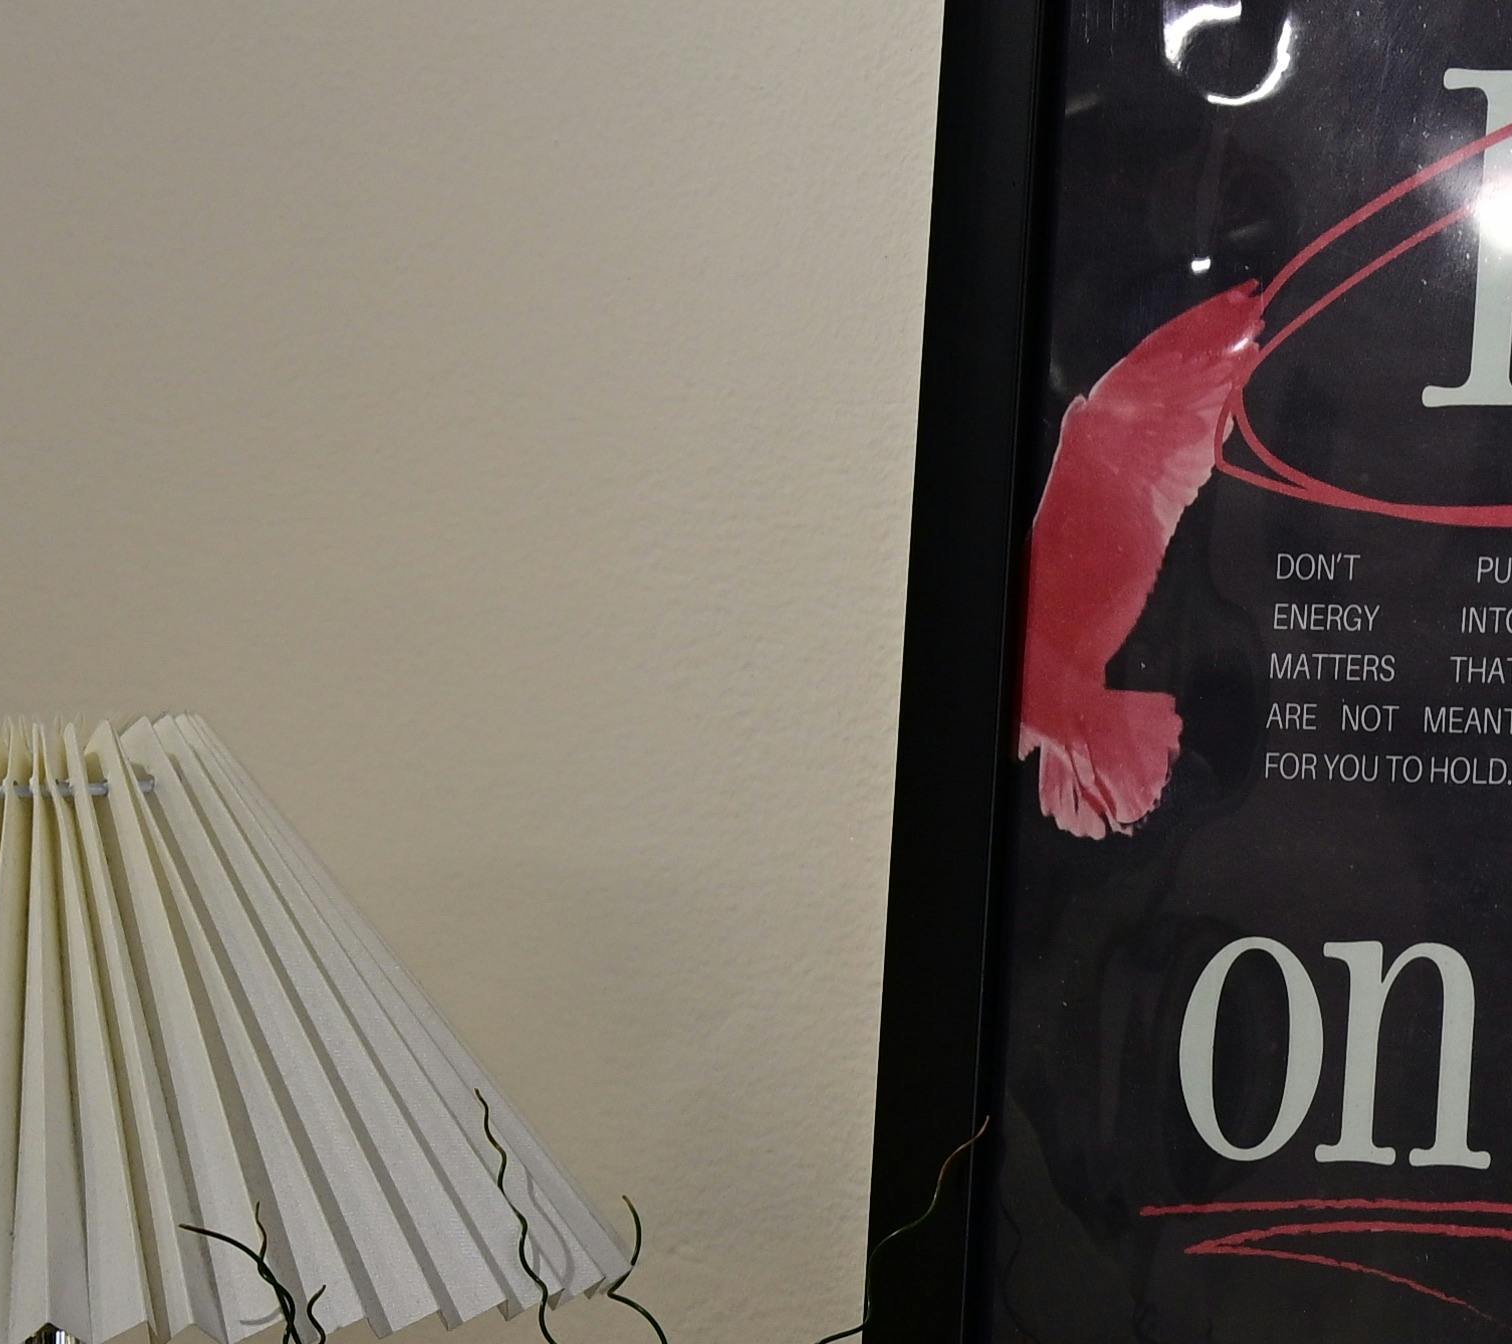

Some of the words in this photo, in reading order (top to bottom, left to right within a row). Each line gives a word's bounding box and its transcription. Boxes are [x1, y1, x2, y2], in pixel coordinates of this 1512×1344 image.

[1276, 553, 1361, 581] DON'T
[1272, 603, 1381, 632] ENERGY
[1268, 652, 1396, 682] MATTERS
[1265, 702, 1318, 731] ARE
[1341, 703, 1400, 732] NOT
[1264, 752, 1317, 780] FOR
[1323, 753, 1379, 782] YOU
[1386, 755, 1423, 783] TO
[1430, 756, 1512, 786] HOLD.
[1177, 935, 1492, 1170] on
